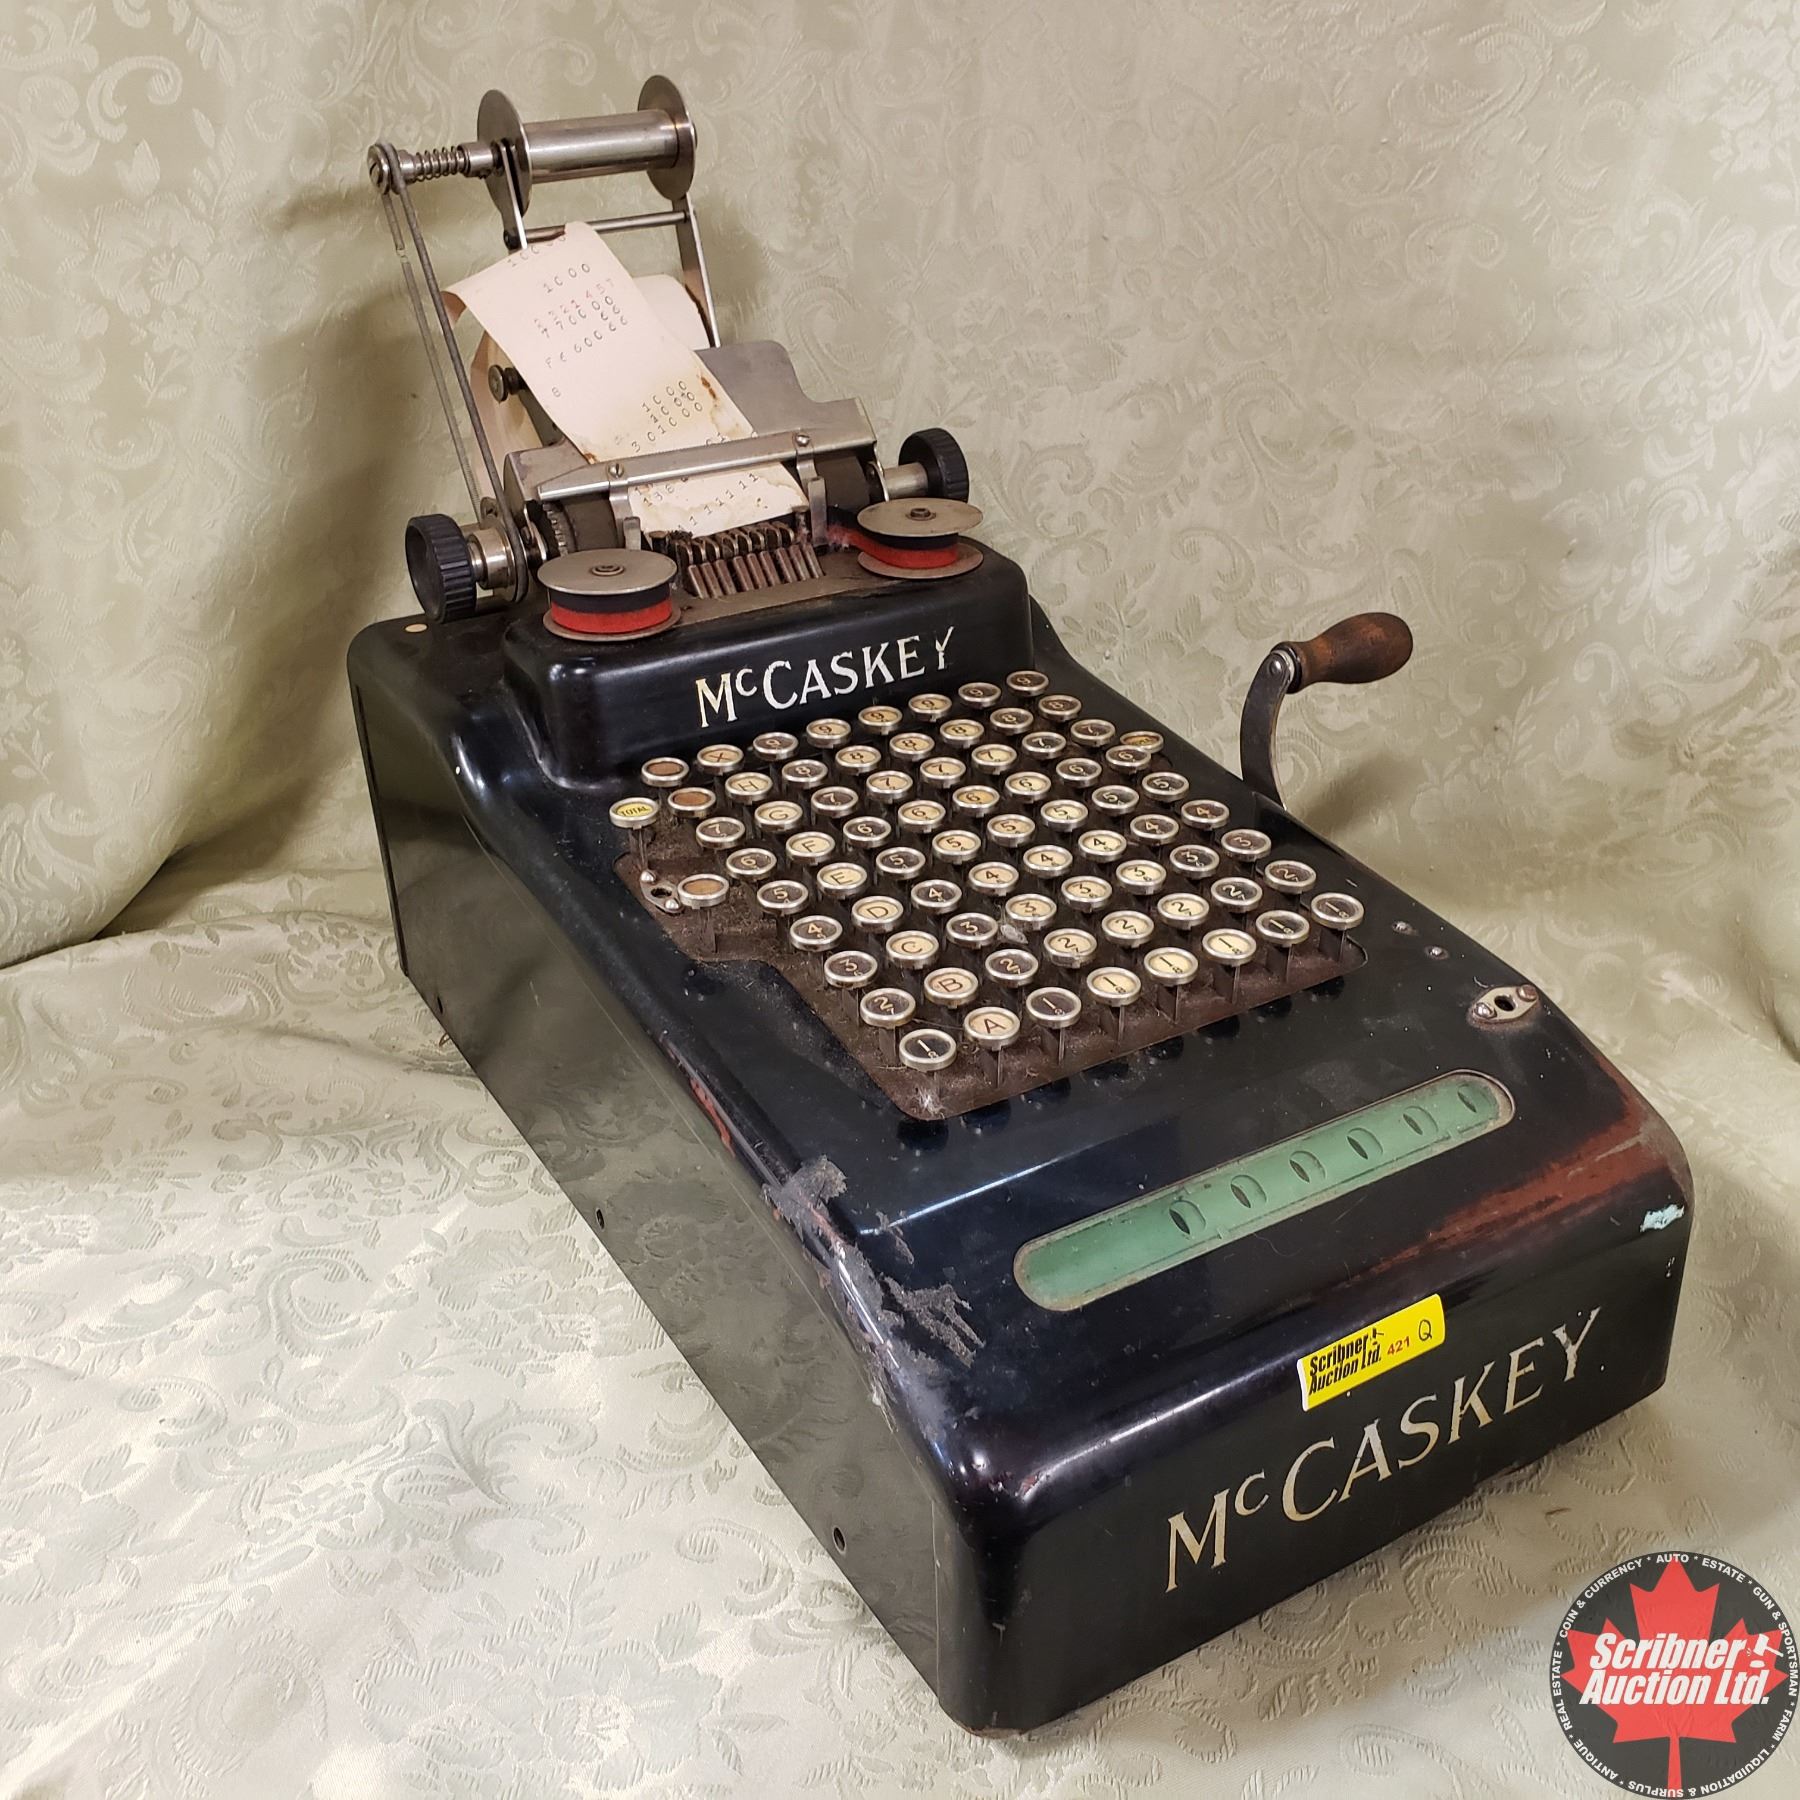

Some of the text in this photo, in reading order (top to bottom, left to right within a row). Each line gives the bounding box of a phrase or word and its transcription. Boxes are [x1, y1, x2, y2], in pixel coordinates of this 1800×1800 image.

[695, 626, 954, 728] McCASKEY
[738, 781, 758, 791] H
[620, 806, 649, 817] TOTAL
[769, 810, 788, 820] G
[802, 840, 816, 852] F
[830, 872, 853, 884] E
[1278, 868, 1294, 879] 2
[1223, 884, 1241, 897] 2
[867, 906, 888, 918] D
[1172, 902, 1189, 913] 2
[1115, 919, 1133, 930] 2
[901, 941, 923, 953] C
[1058, 937, 1076, 949] 2
[1000, 959, 1018, 971] 2
[938, 977, 963, 992] B
[874, 997, 893, 1010] 2
[984, 1018, 1006, 1034] A
[1418, 1319, 1433, 1341] Q
[1387, 1336, 1410, 1355] 421
[1310, 1334, 1368, 1376] Scribner
[1309, 1344, 1381, 1395] Auction Ltd.
[1166, 1306, 1600, 1592] McCASKEY
